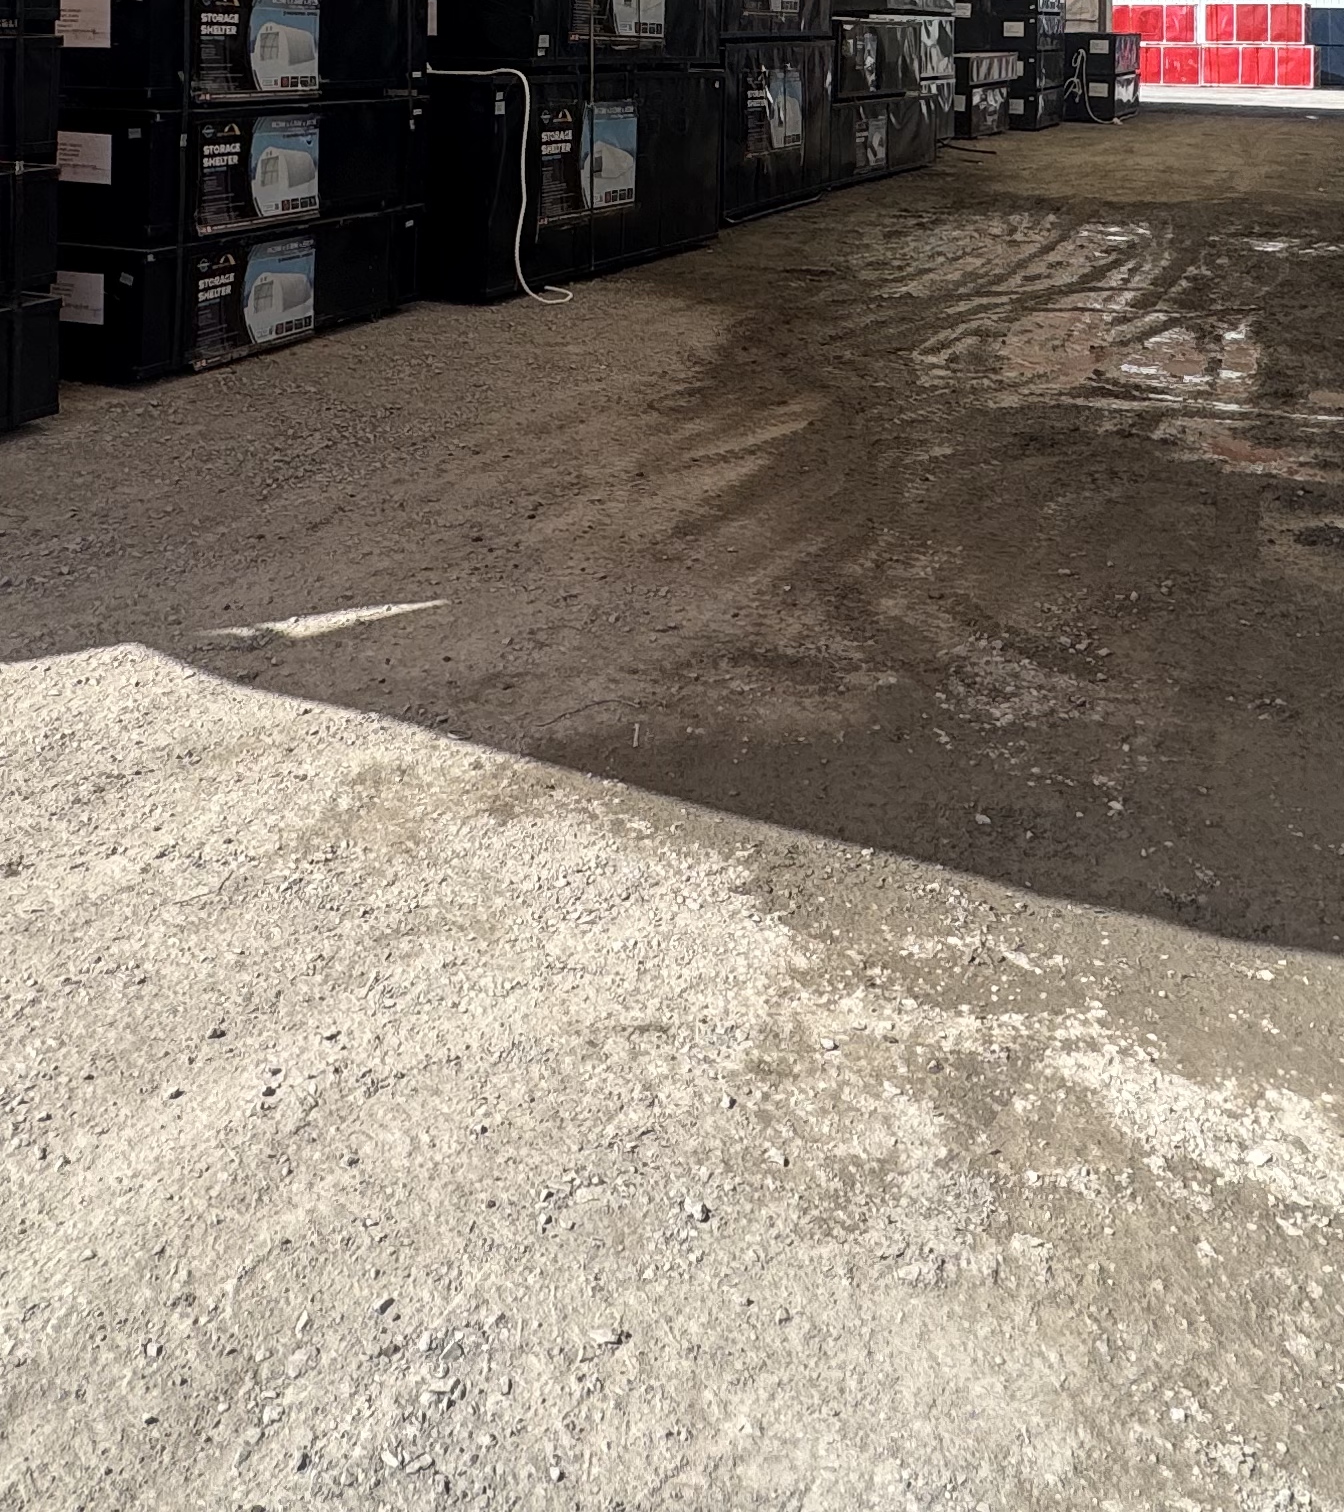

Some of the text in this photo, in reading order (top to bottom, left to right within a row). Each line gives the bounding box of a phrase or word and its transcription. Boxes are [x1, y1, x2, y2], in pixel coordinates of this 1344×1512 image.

[201, 13, 239, 23] STORAGE
[201, 25, 237, 35] SHELTER
[203, 143, 241, 155] STORAGE
[203, 155, 239, 167] SHELTER
